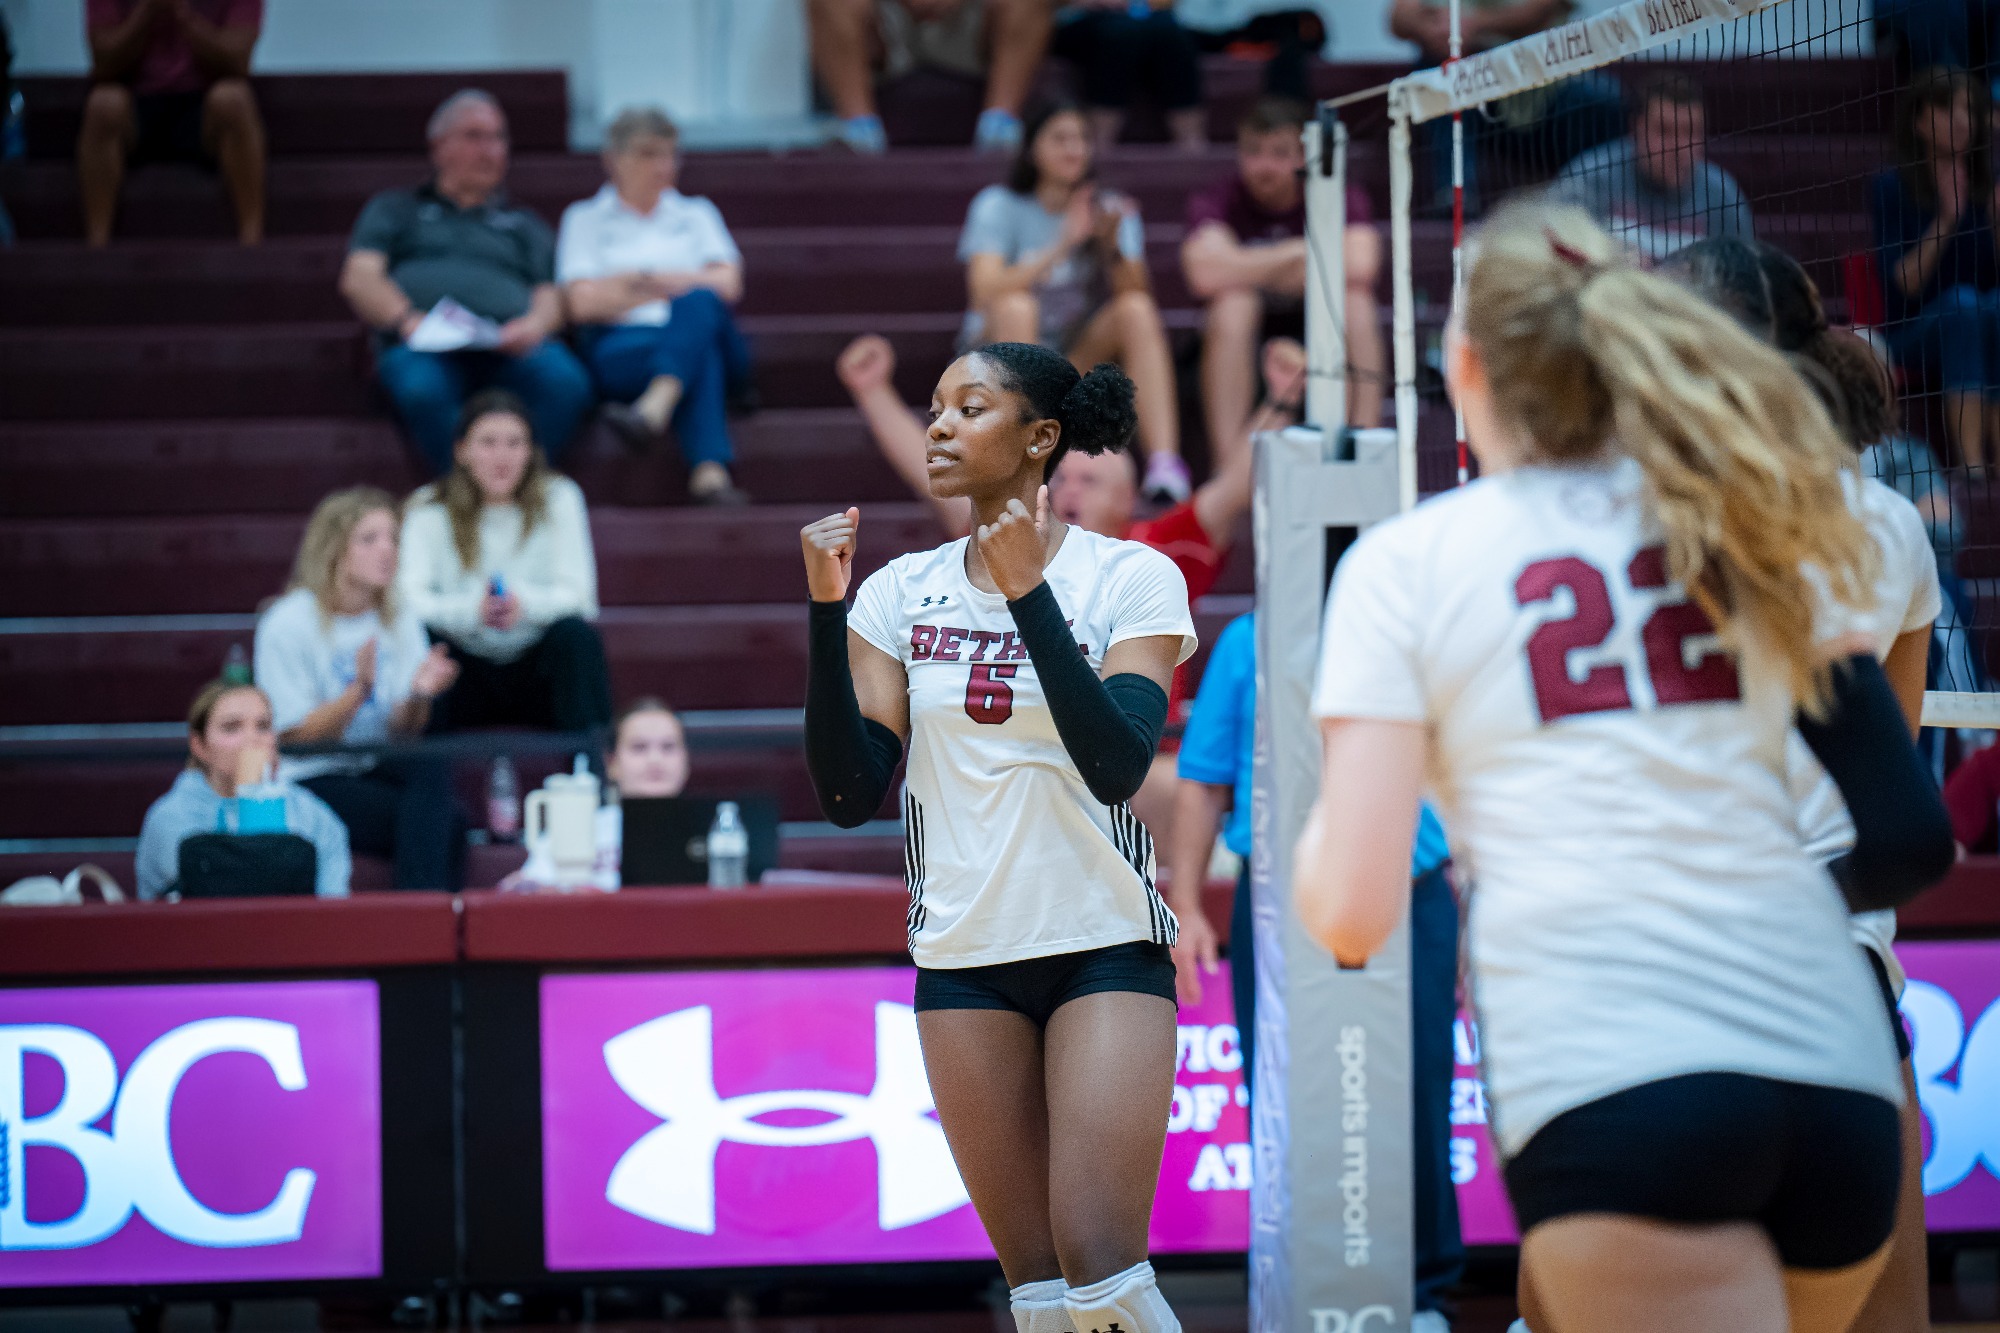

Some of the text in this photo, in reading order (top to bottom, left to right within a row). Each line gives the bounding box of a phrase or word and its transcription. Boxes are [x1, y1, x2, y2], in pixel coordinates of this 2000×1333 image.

[911, 619, 1090, 661] BETH
[964, 664, 1018, 725] 6
[1514, 545, 1741, 723] 22
[0, 1015, 318, 1251] BC
[1337, 1025, 1372, 1267] sports imports
